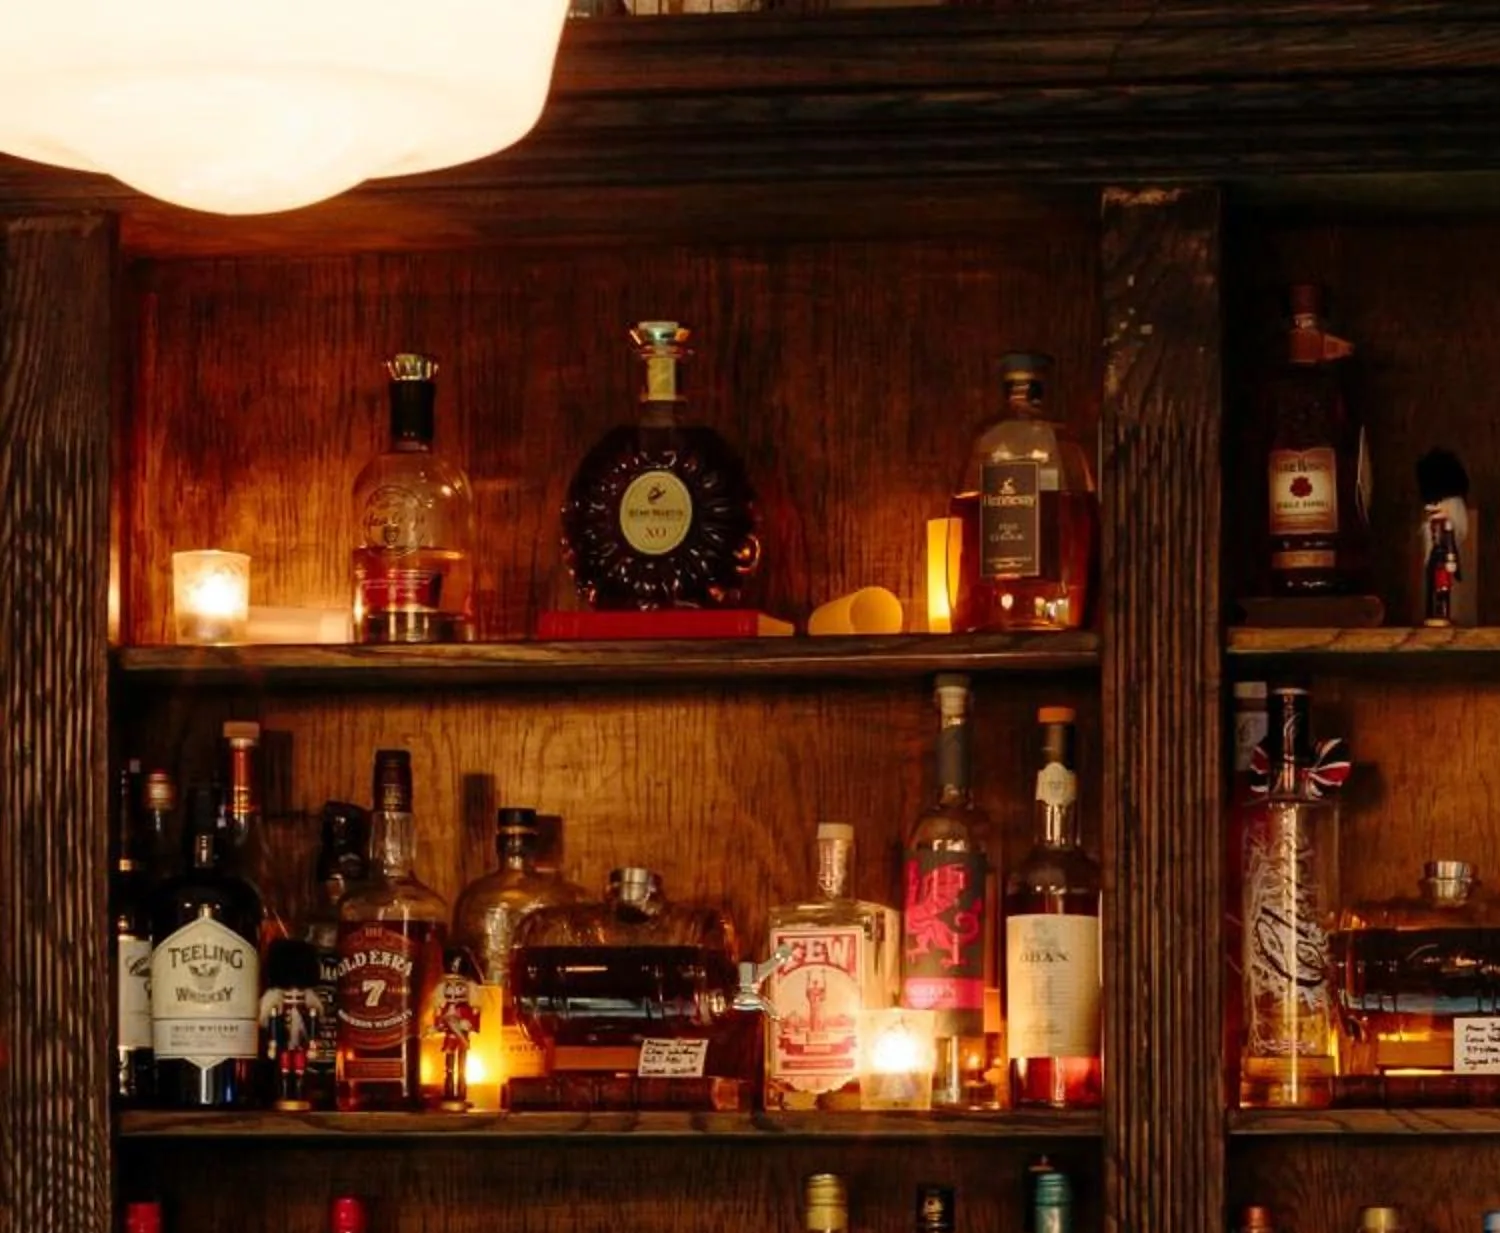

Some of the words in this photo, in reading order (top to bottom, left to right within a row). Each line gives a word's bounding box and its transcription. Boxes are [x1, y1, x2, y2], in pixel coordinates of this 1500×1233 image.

[167, 943, 244, 971] TEELING
[175, 986, 235, 1005] WHISKEY
[361, 979, 387, 1007] 7
